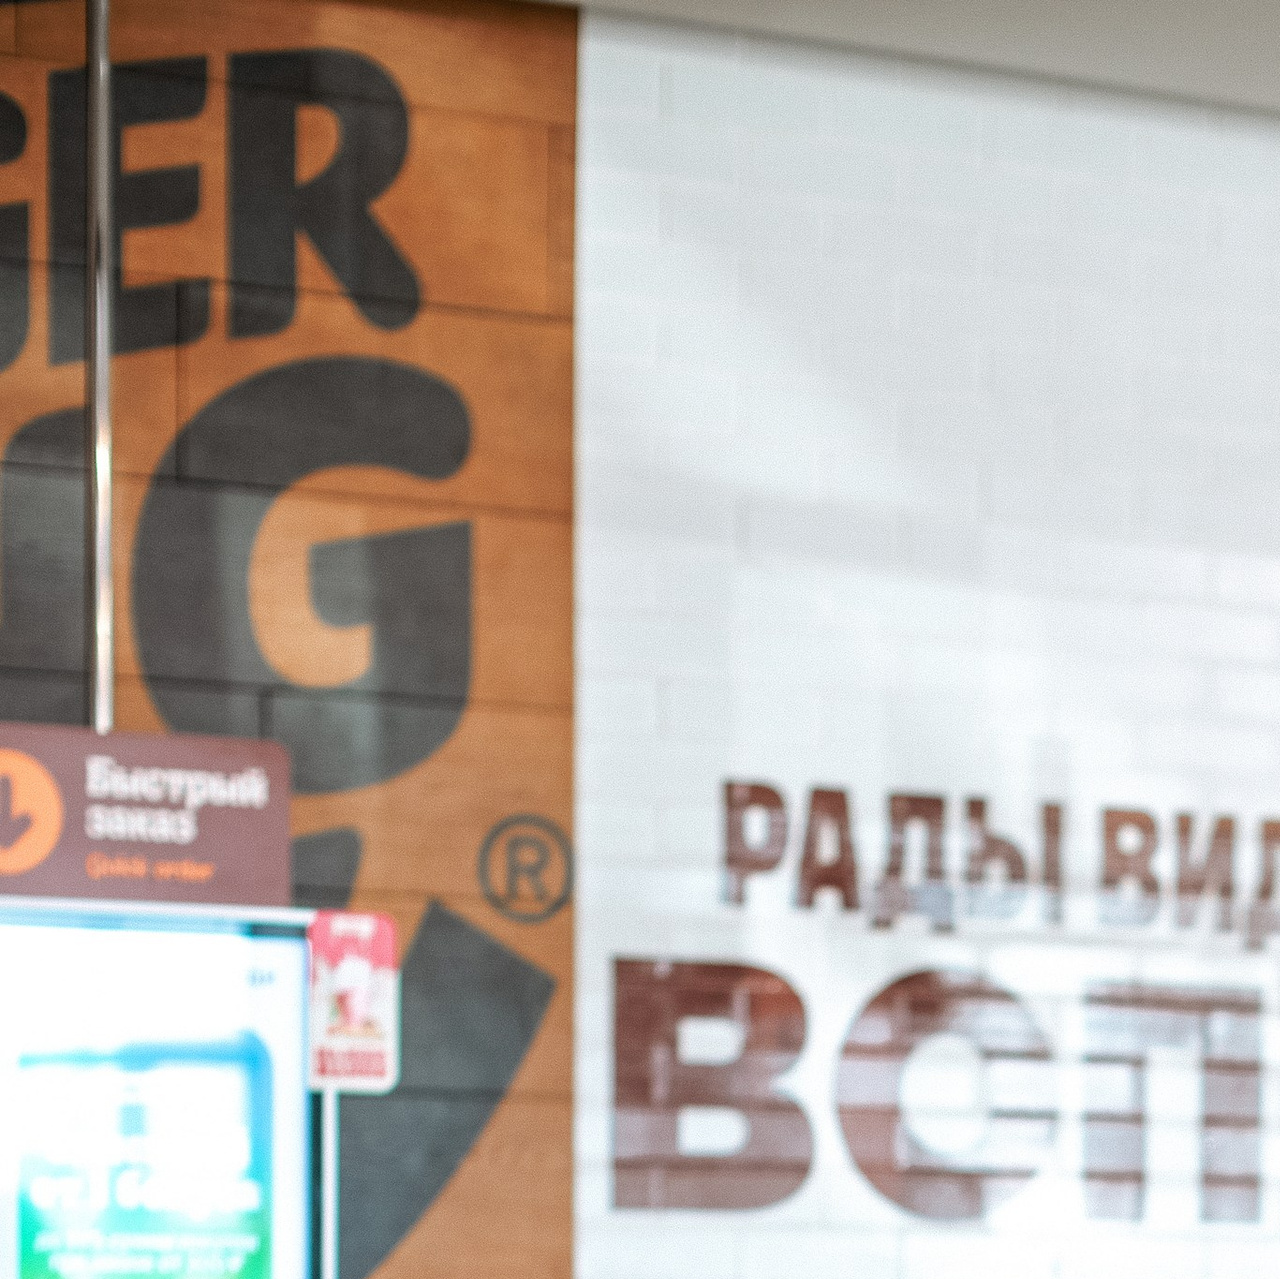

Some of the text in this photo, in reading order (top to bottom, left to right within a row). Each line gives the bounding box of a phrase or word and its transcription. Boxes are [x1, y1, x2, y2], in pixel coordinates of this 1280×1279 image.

[85, 754, 270, 811] Быстрый
[85, 802, 198, 845] заказ
[720, 780, 1063, 938] РАДЫ
